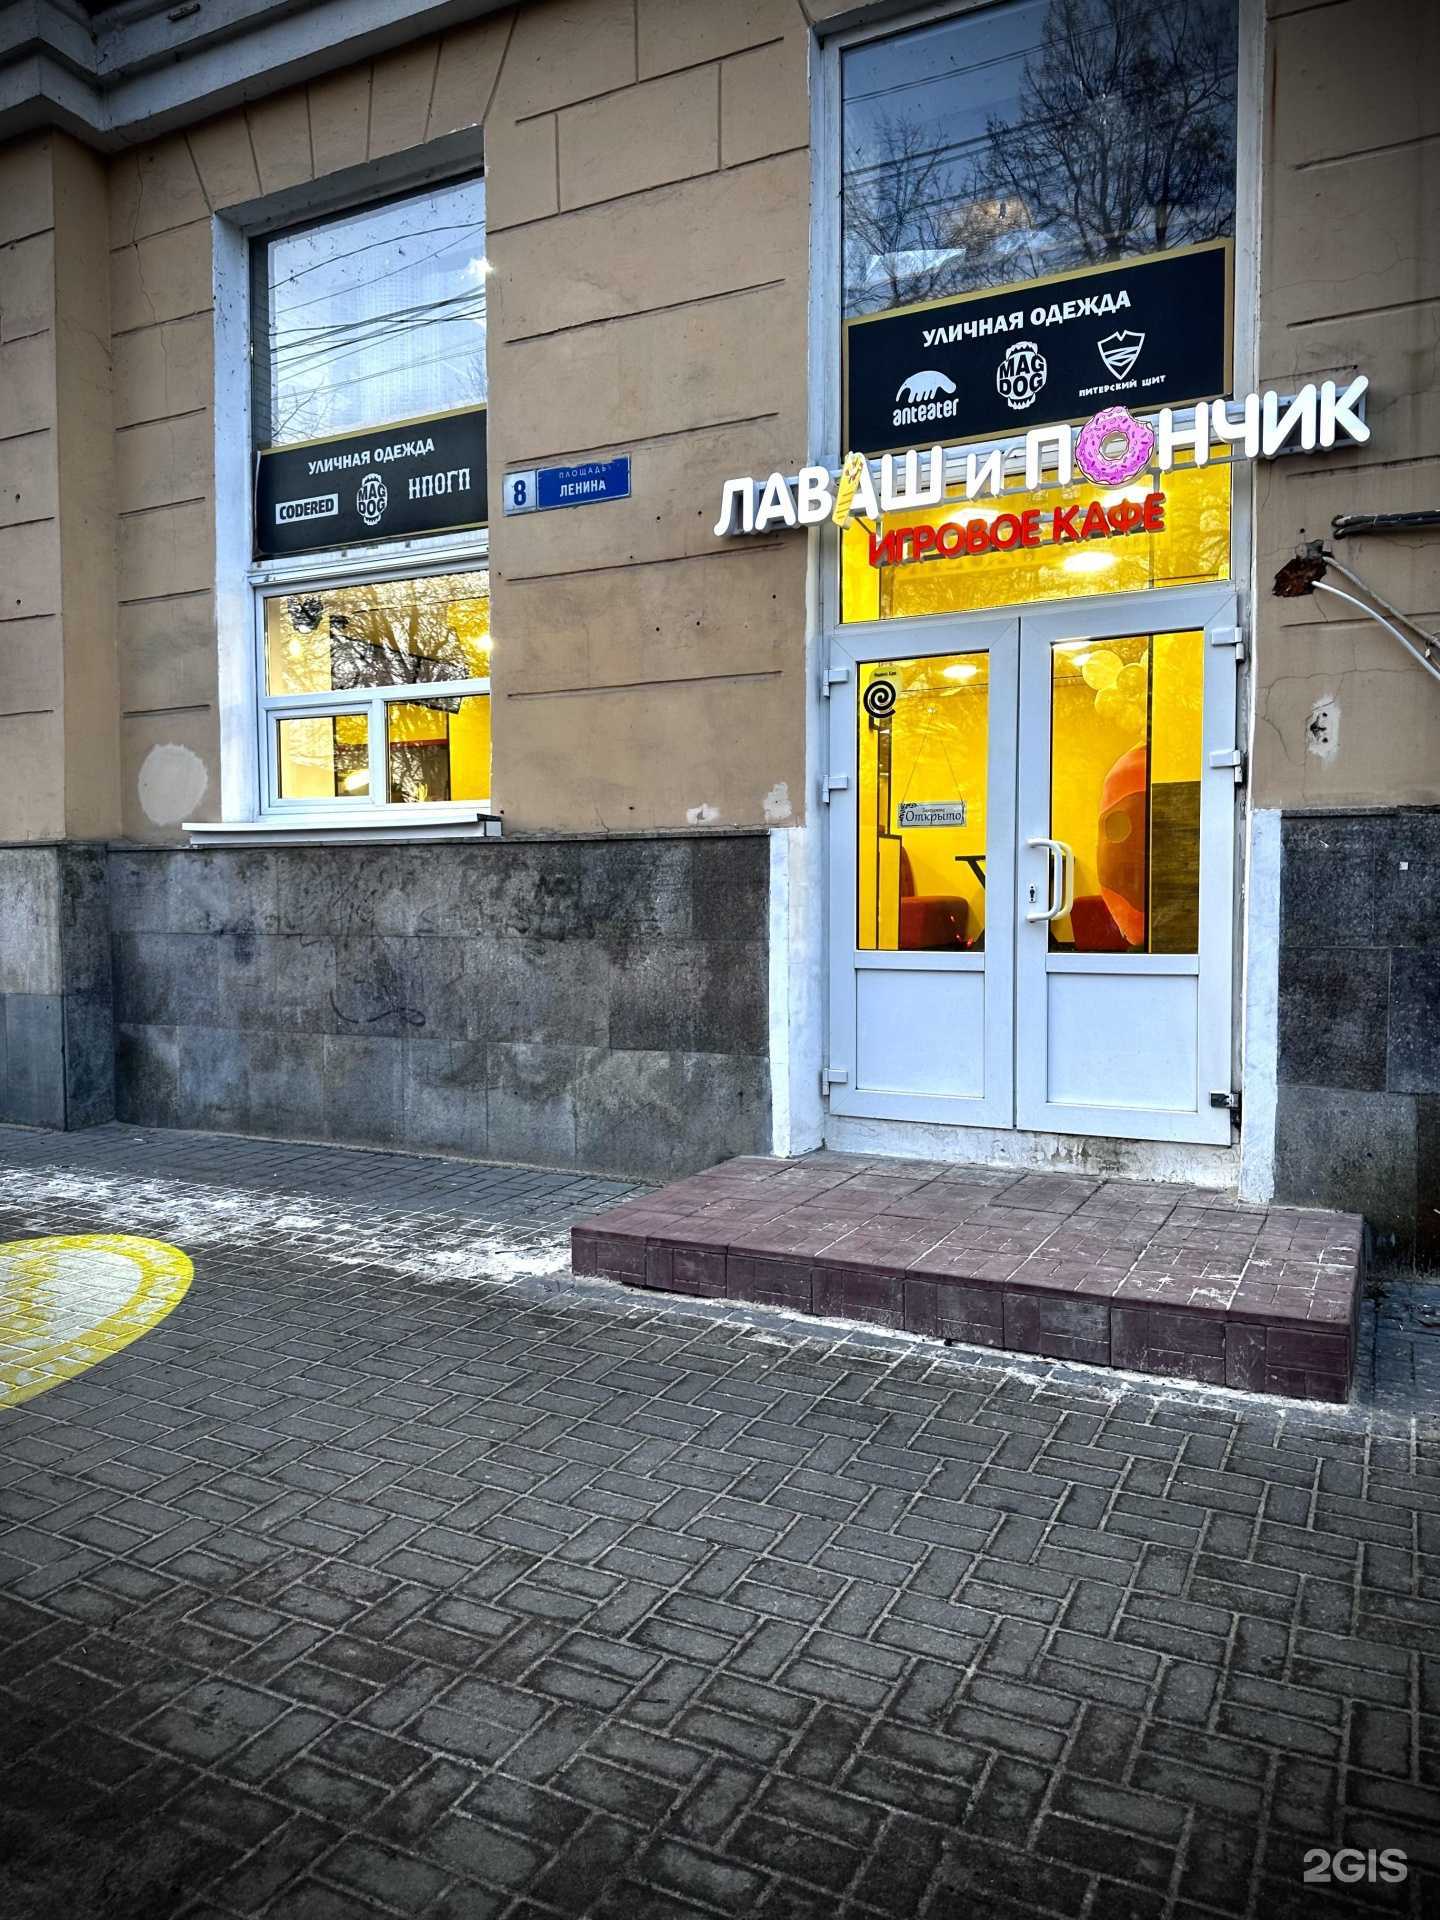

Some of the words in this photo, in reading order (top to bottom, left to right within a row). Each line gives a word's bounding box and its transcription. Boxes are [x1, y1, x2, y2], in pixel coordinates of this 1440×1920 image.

[922, 311, 1024, 348] УЛИЧНАЯ
[1029, 290, 1131, 326] ОДЕЖДА
[1000, 354, 1045, 379] MAG
[999, 376, 1044, 399] DOG
[1078, 378, 1138, 397] ПИТЕРСКИЙ
[892, 398, 959, 427] anteater
[308, 450, 371, 476] УЛИЧНАЯ
[374, 438, 435, 463] ОДЕЖДА
[359, 487, 387, 502] MAG
[408, 468, 471, 500] НПОГП
[513, 479, 527, 506] 8
[560, 479, 607, 498] ЛЕНИНА
[713, 445, 944, 538] ЛАВАШ
[279, 498, 334, 520] CODERED
[358, 499, 386, 516] DOG
[868, 508, 1043, 568] ИГРОВОЕ
[1051, 491, 1166, 544] КАФЕ
[905, 810, 962, 824] Открыто
